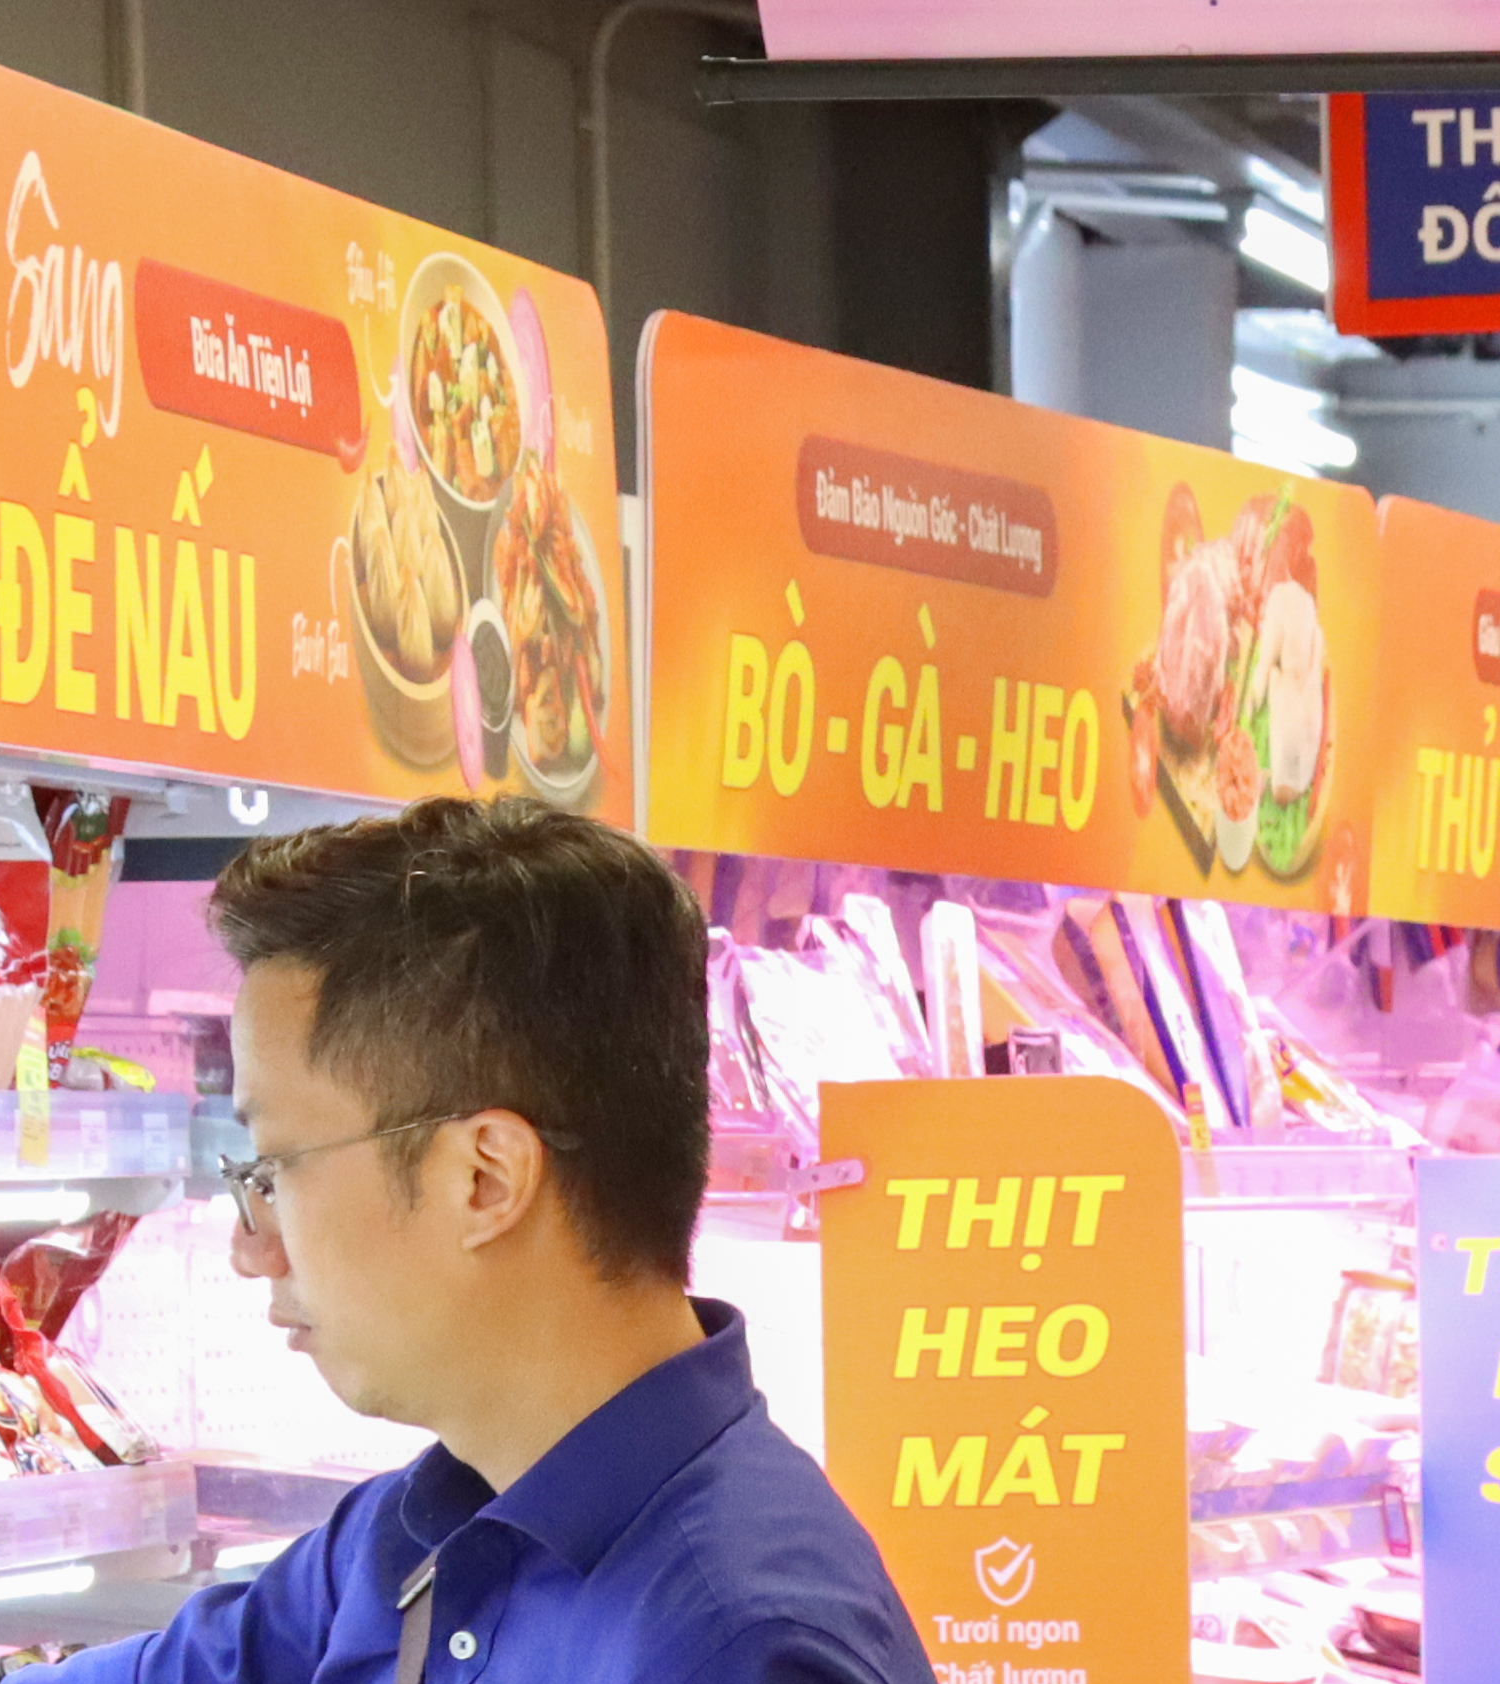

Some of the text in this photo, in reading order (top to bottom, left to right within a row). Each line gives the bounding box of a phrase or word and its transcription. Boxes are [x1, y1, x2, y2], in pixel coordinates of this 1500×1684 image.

[190, 312, 314, 418] Bữa Ăn Tiện Lợi
[815, 466, 850, 523] Đảm
[852, 474, 880, 530] Bảo
[882, 484, 929, 546] Nguồn
[930, 493, 958, 545] Gốc
[968, 502, 1000, 554] Chất
[1000, 511, 1043, 574] Lượng
[115, 444, 257, 741] NẤU
[722, 579, 816, 797] BÒ
[861, 603, 943, 813] GÀ
[984, 676, 1100, 833] HEO
[885, 1174, 1126, 1272] THỊT
[893, 1304, 1110, 1380] HEO
[891, 1406, 1126, 1508] MÁT
[932, 1614, 1081, 1650] Tươi ngon
